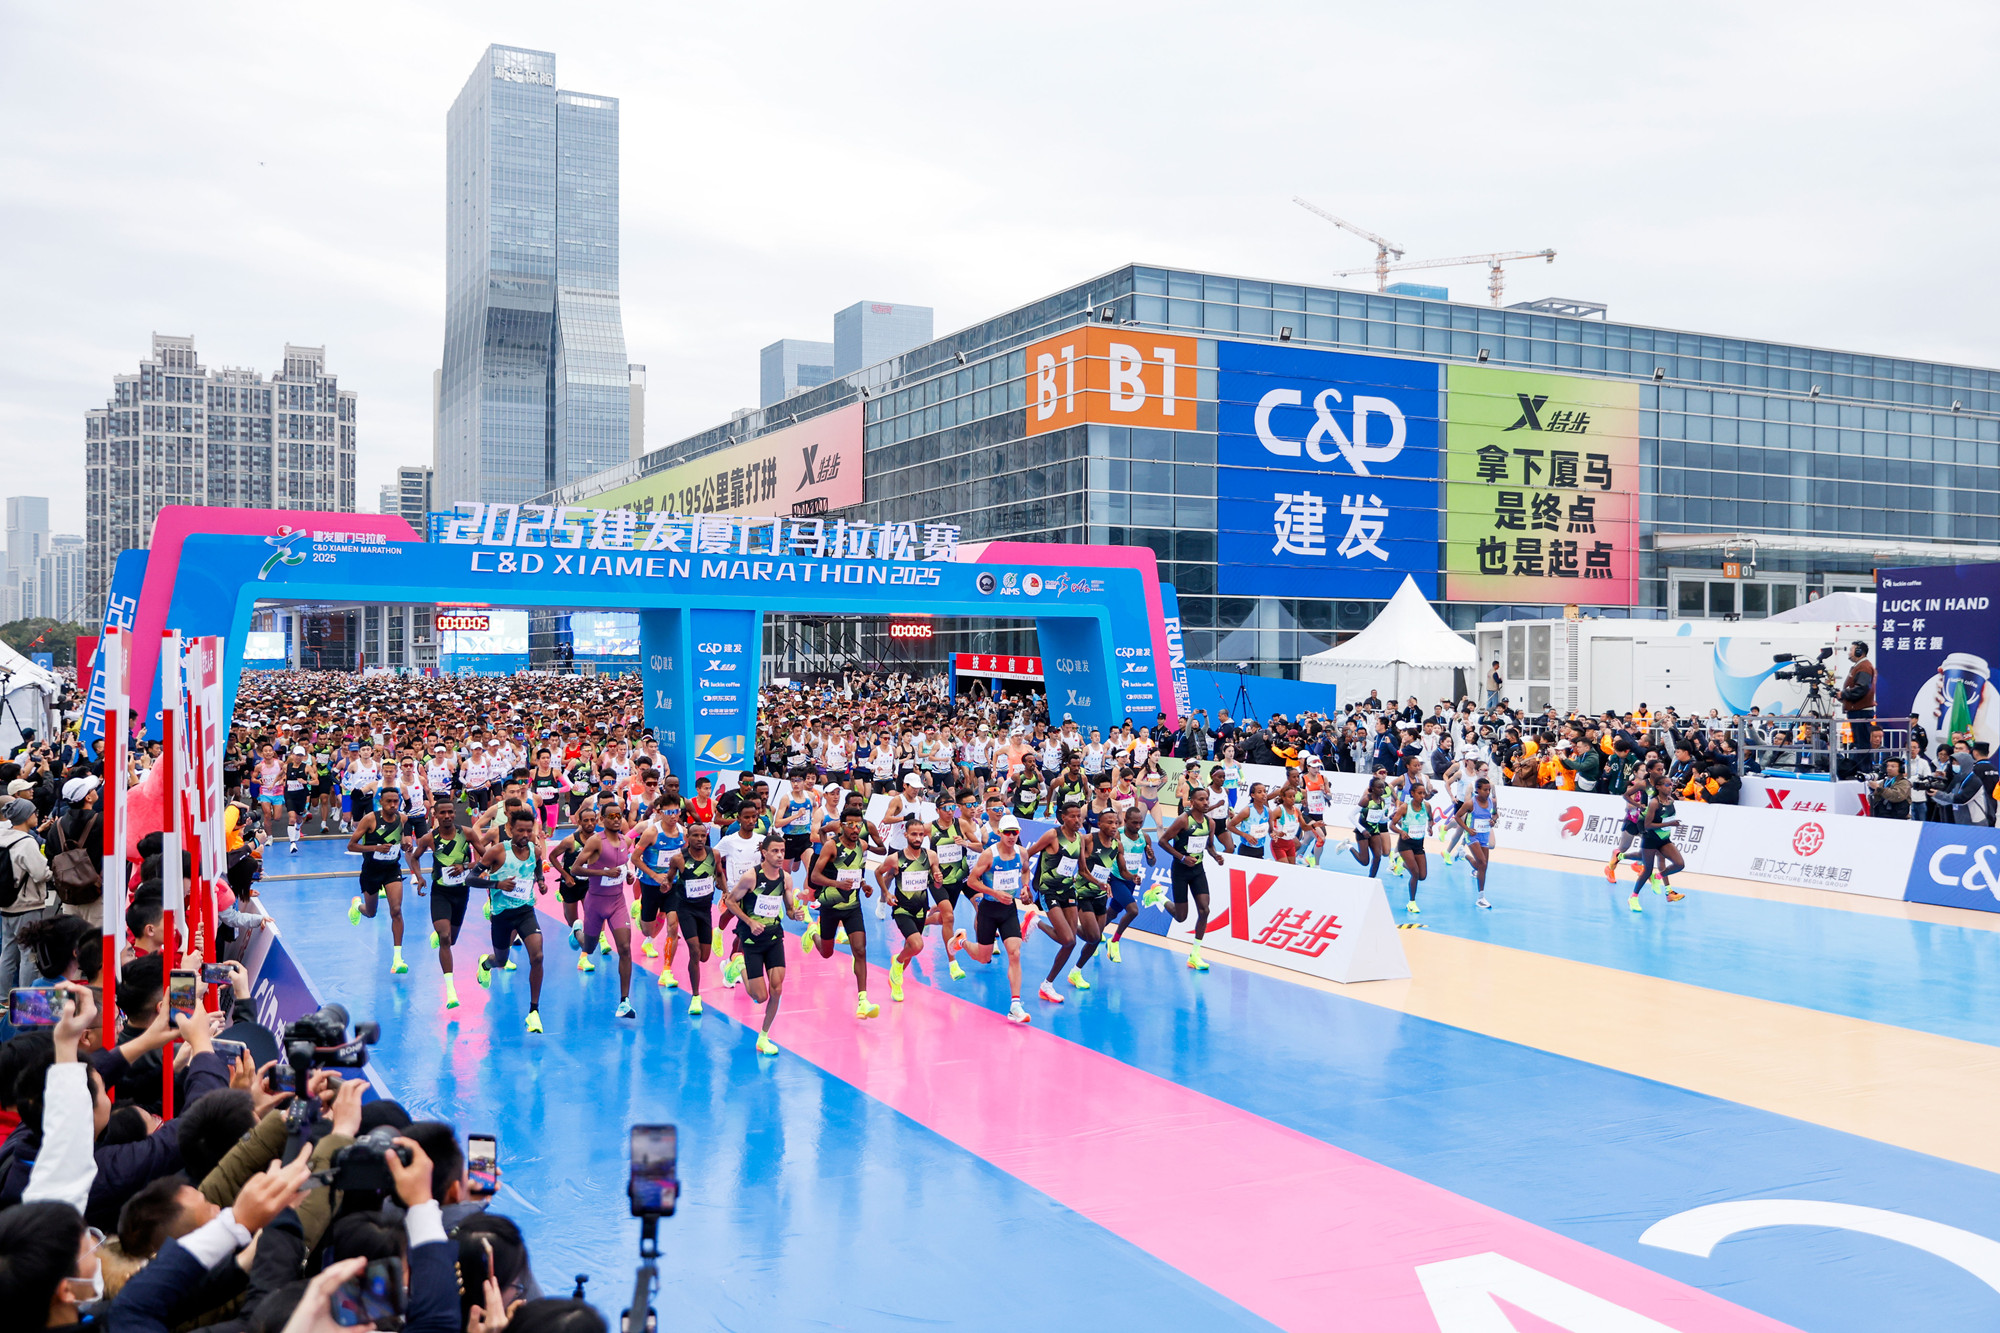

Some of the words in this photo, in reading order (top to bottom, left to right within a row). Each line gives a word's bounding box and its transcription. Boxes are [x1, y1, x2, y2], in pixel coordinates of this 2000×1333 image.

[1037, 344, 1075, 421] B1
[1109, 342, 1176, 416] B1
[1545, 411, 1590, 434] 特步
[1254, 388, 1407, 476] C&D
[816, 452, 841, 483] 特步
[1476, 444, 1613, 490] 拿下厦马
[1494, 491, 1596, 534] 是终点
[446, 501, 961, 563] 2025建发厦门马拉松赛
[1271, 491, 1390, 562] 建发
[312, 530, 387, 545] 建发厦门马拉松
[312, 544, 328, 552] C&D
[329, 545, 359, 553] XIAMEN
[361, 547, 402, 555] MARATHON
[312, 553, 336, 563] 2025
[1476, 535, 1613, 579] 也是起点
[471, 551, 544, 574] C&D
[552, 554, 691, 579] XIAMEN
[1727, 565, 1737, 576] B1
[1000, 587, 1020, 596] AIMS
[1882, 599, 1922, 613] LUCK
[1925, 598, 1941, 612] IN
[1944, 597, 1990, 611] HAND
[437, 616, 489, 631] 00:00:05
[890, 624, 932, 638] 00:00:05
[1881, 618, 1926, 633] 这一杯
[697, 642, 722, 655] C&D
[723, 643, 743, 653] 建发
[1163, 617, 1187, 669] RUN
[1881, 636, 1944, 651] 幸运在握
[1115, 647, 1135, 658] C&D
[1135, 648, 1151, 657] 建发
[972, 655, 1035, 673] 技术信息
[1056, 658, 1074, 675] C&D
[1075, 659, 1090, 673] 建发
[1749, 871, 1772, 879] XIAMEN
[1773, 874, 1801, 883] CULTURE
[1750, 857, 1853, 882] 厦门文广传媒集团
[1928, 844, 2000, 901] C&
[689, 883, 711, 892] KABETO
[1251, 907, 1342, 958] 特步
